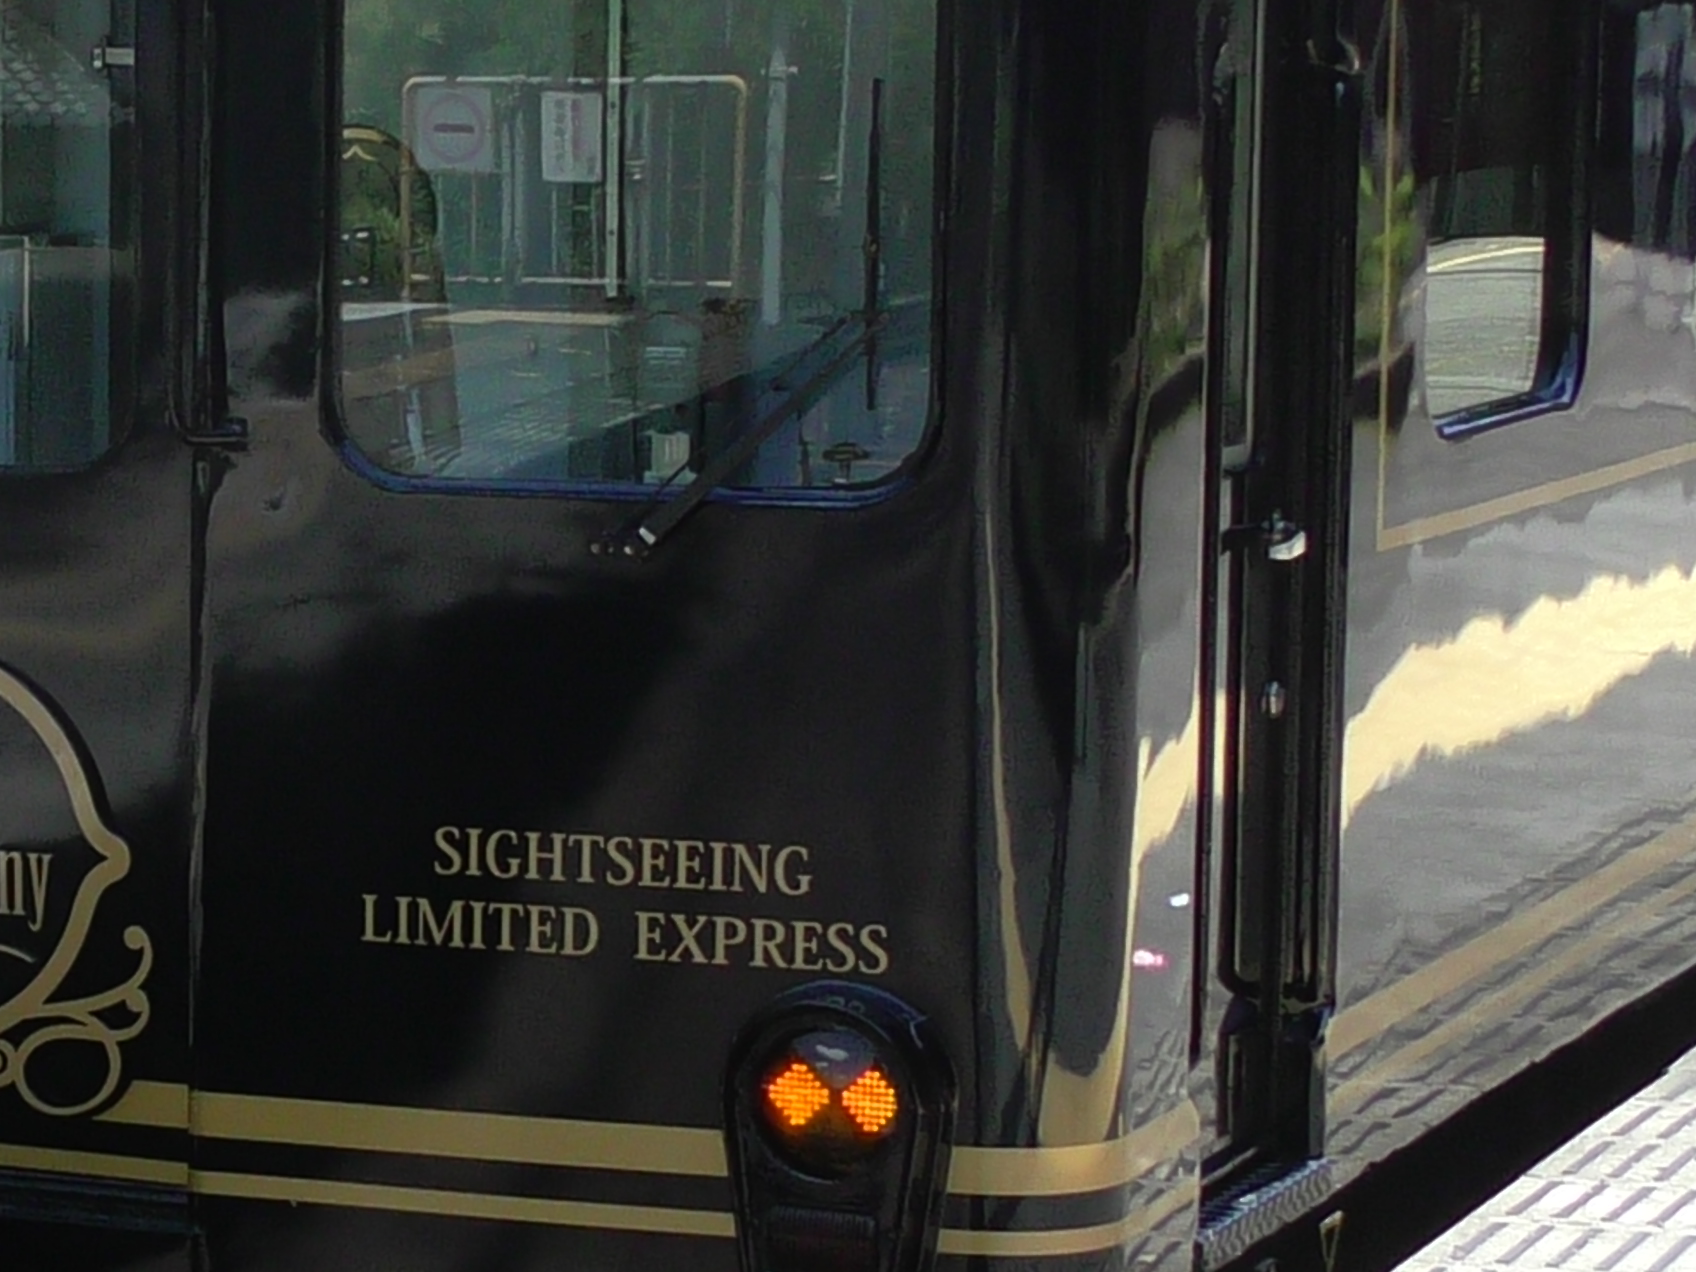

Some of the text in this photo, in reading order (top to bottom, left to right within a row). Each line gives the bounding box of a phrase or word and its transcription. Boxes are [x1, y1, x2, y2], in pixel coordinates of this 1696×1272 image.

[433, 825, 813, 897] SIGHTSEEING
[360, 893, 890, 976] LIMITED EXPRESS
